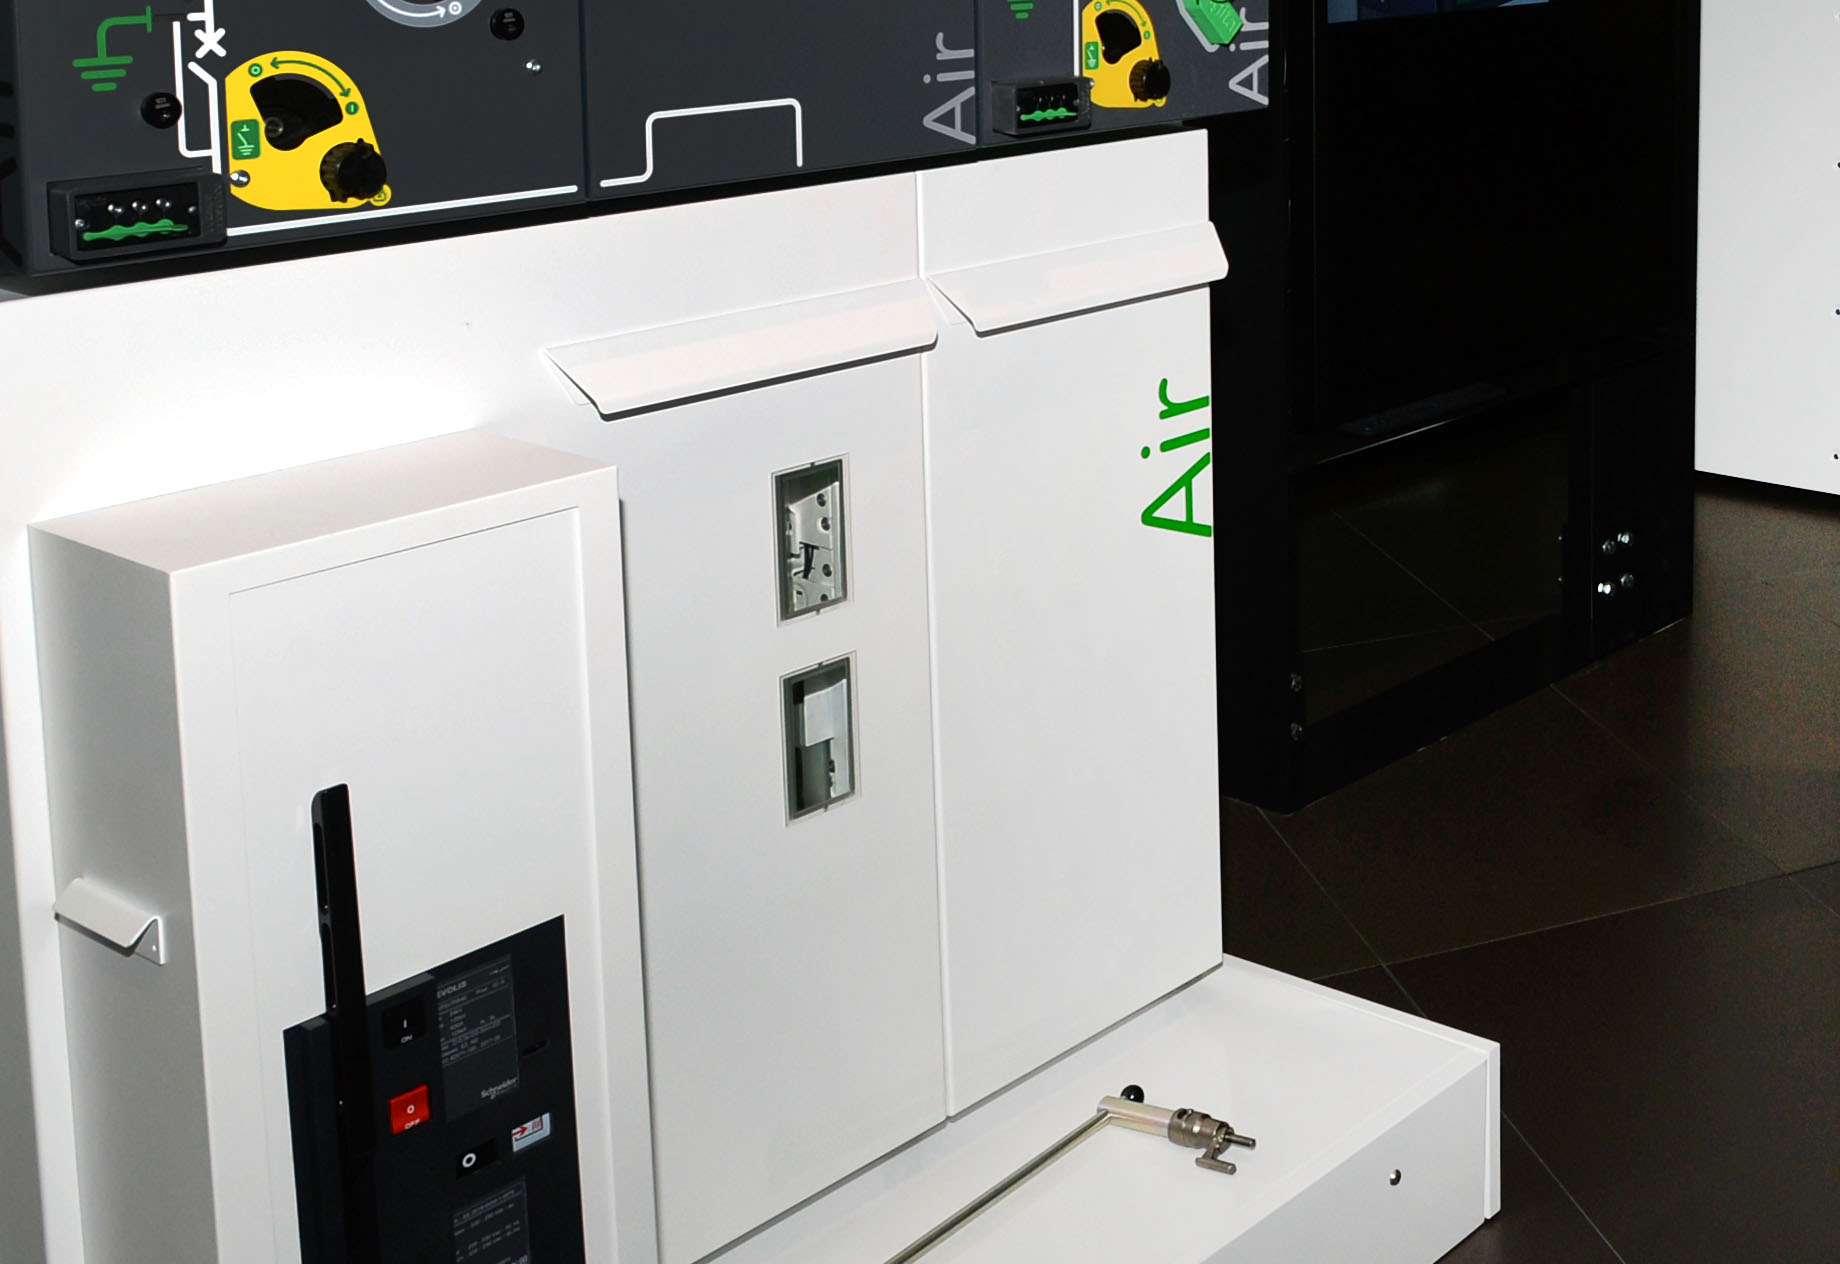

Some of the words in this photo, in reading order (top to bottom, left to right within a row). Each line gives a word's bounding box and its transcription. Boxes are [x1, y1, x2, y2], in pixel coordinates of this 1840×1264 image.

[922, 30, 976, 145] Air
[1228, 6, 1269, 106] Air
[1141, 377, 1212, 538] Air
[400, 1033, 414, 1044] ON
